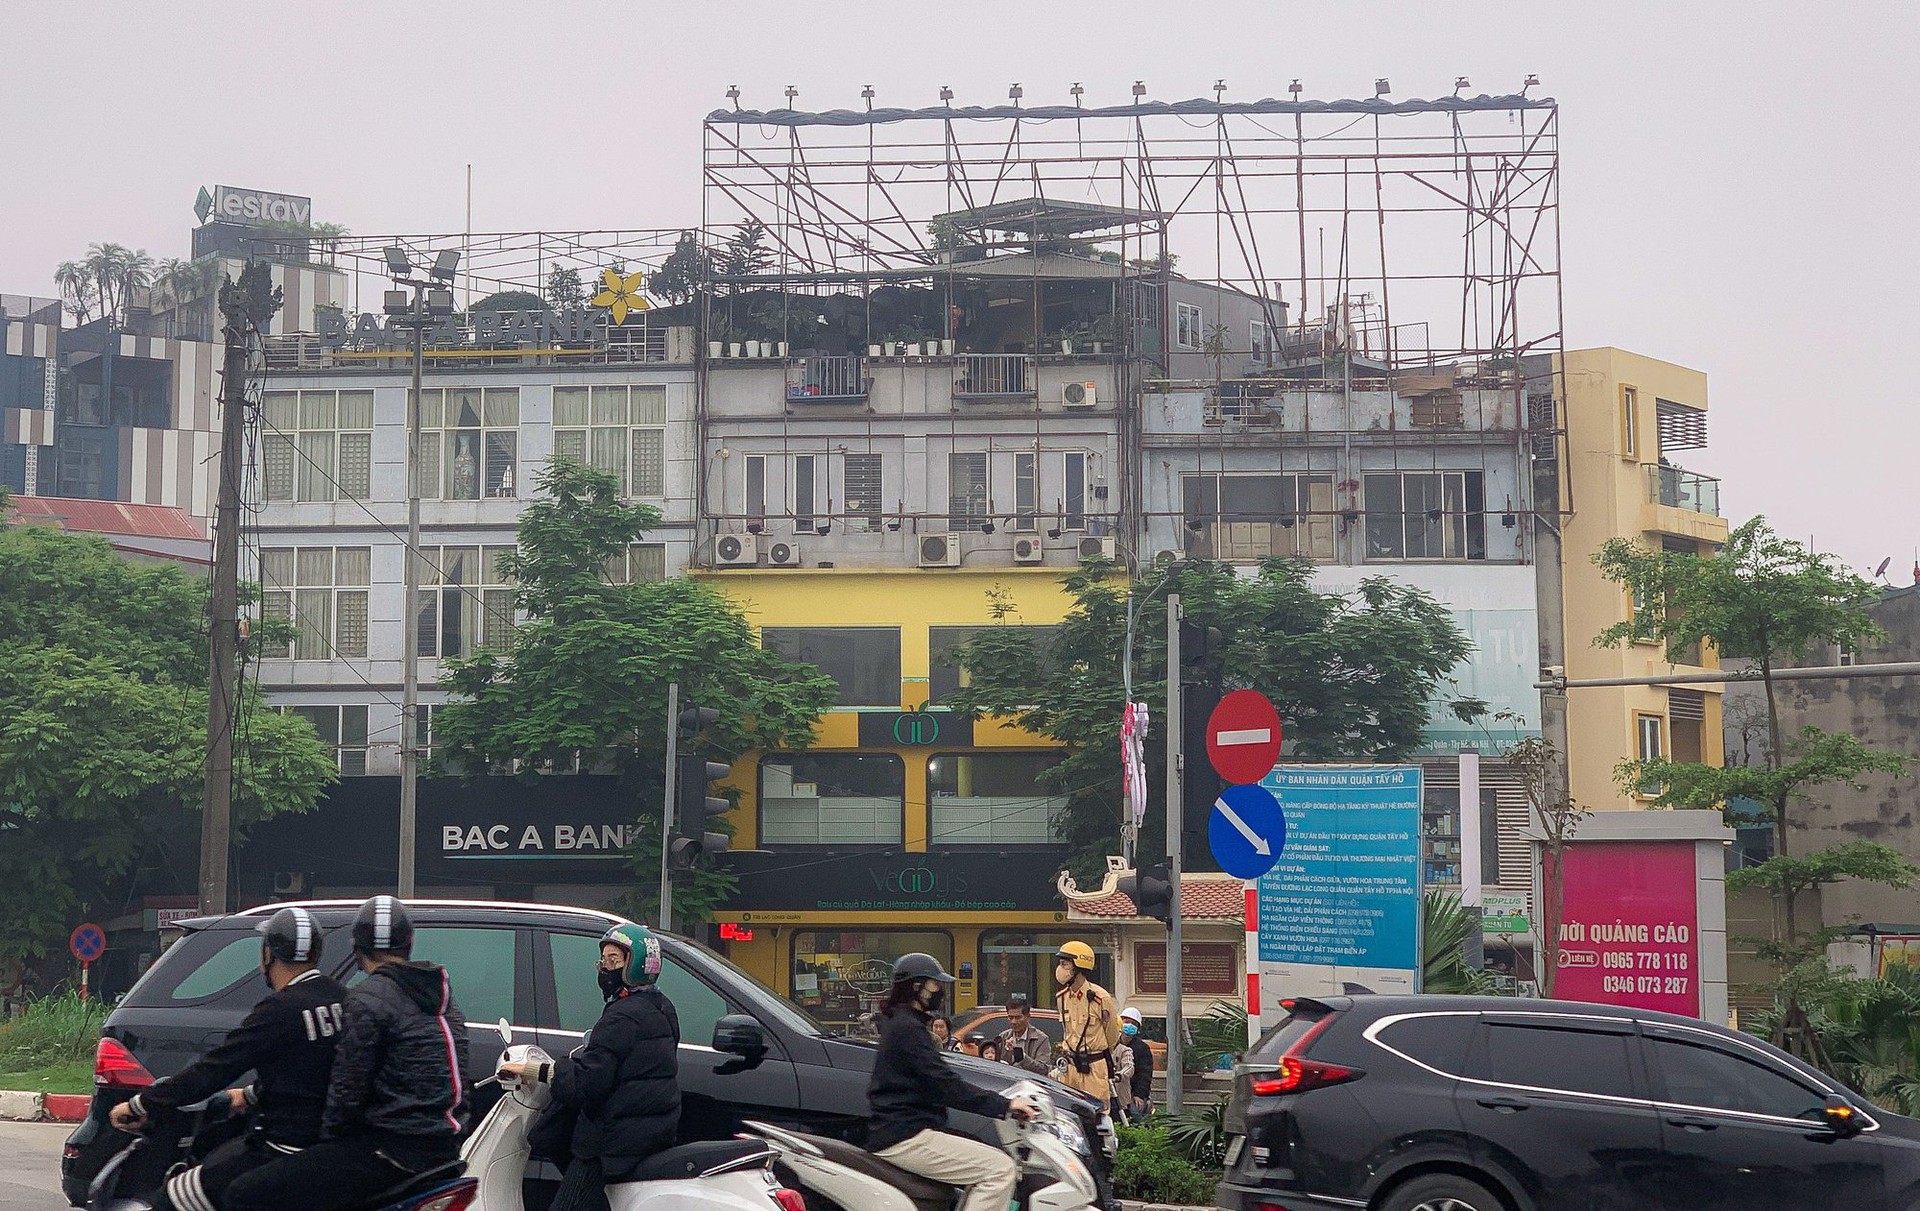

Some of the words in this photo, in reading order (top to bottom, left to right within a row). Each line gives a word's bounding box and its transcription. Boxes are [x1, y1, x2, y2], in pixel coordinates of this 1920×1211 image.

[475, 310, 604, 343] BANK
[1288, 776, 1304, 784] BAN
[1306, 774, 1328, 784] NHÂN
[1331, 774, 1347, 785] DÂN
[1350, 775, 1373, 787] QUẬN
[1375, 774, 1390, 784] TÂY
[1392, 772, 1404, 784] HỒ
[443, 824, 510, 850] BAC
[518, 825, 544, 850] A
[1590, 918, 1648, 944] QUẢNG
[1654, 922, 1689, 944] CÁO
[1603, 952, 1633, 969] 0965
[1637, 952, 1661, 970] 778
[1664, 952, 1688, 970] 118
[1604, 976, 1634, 993] 0346
[1638, 976, 1661, 994] 073
[1665, 977, 1688, 994] 287
